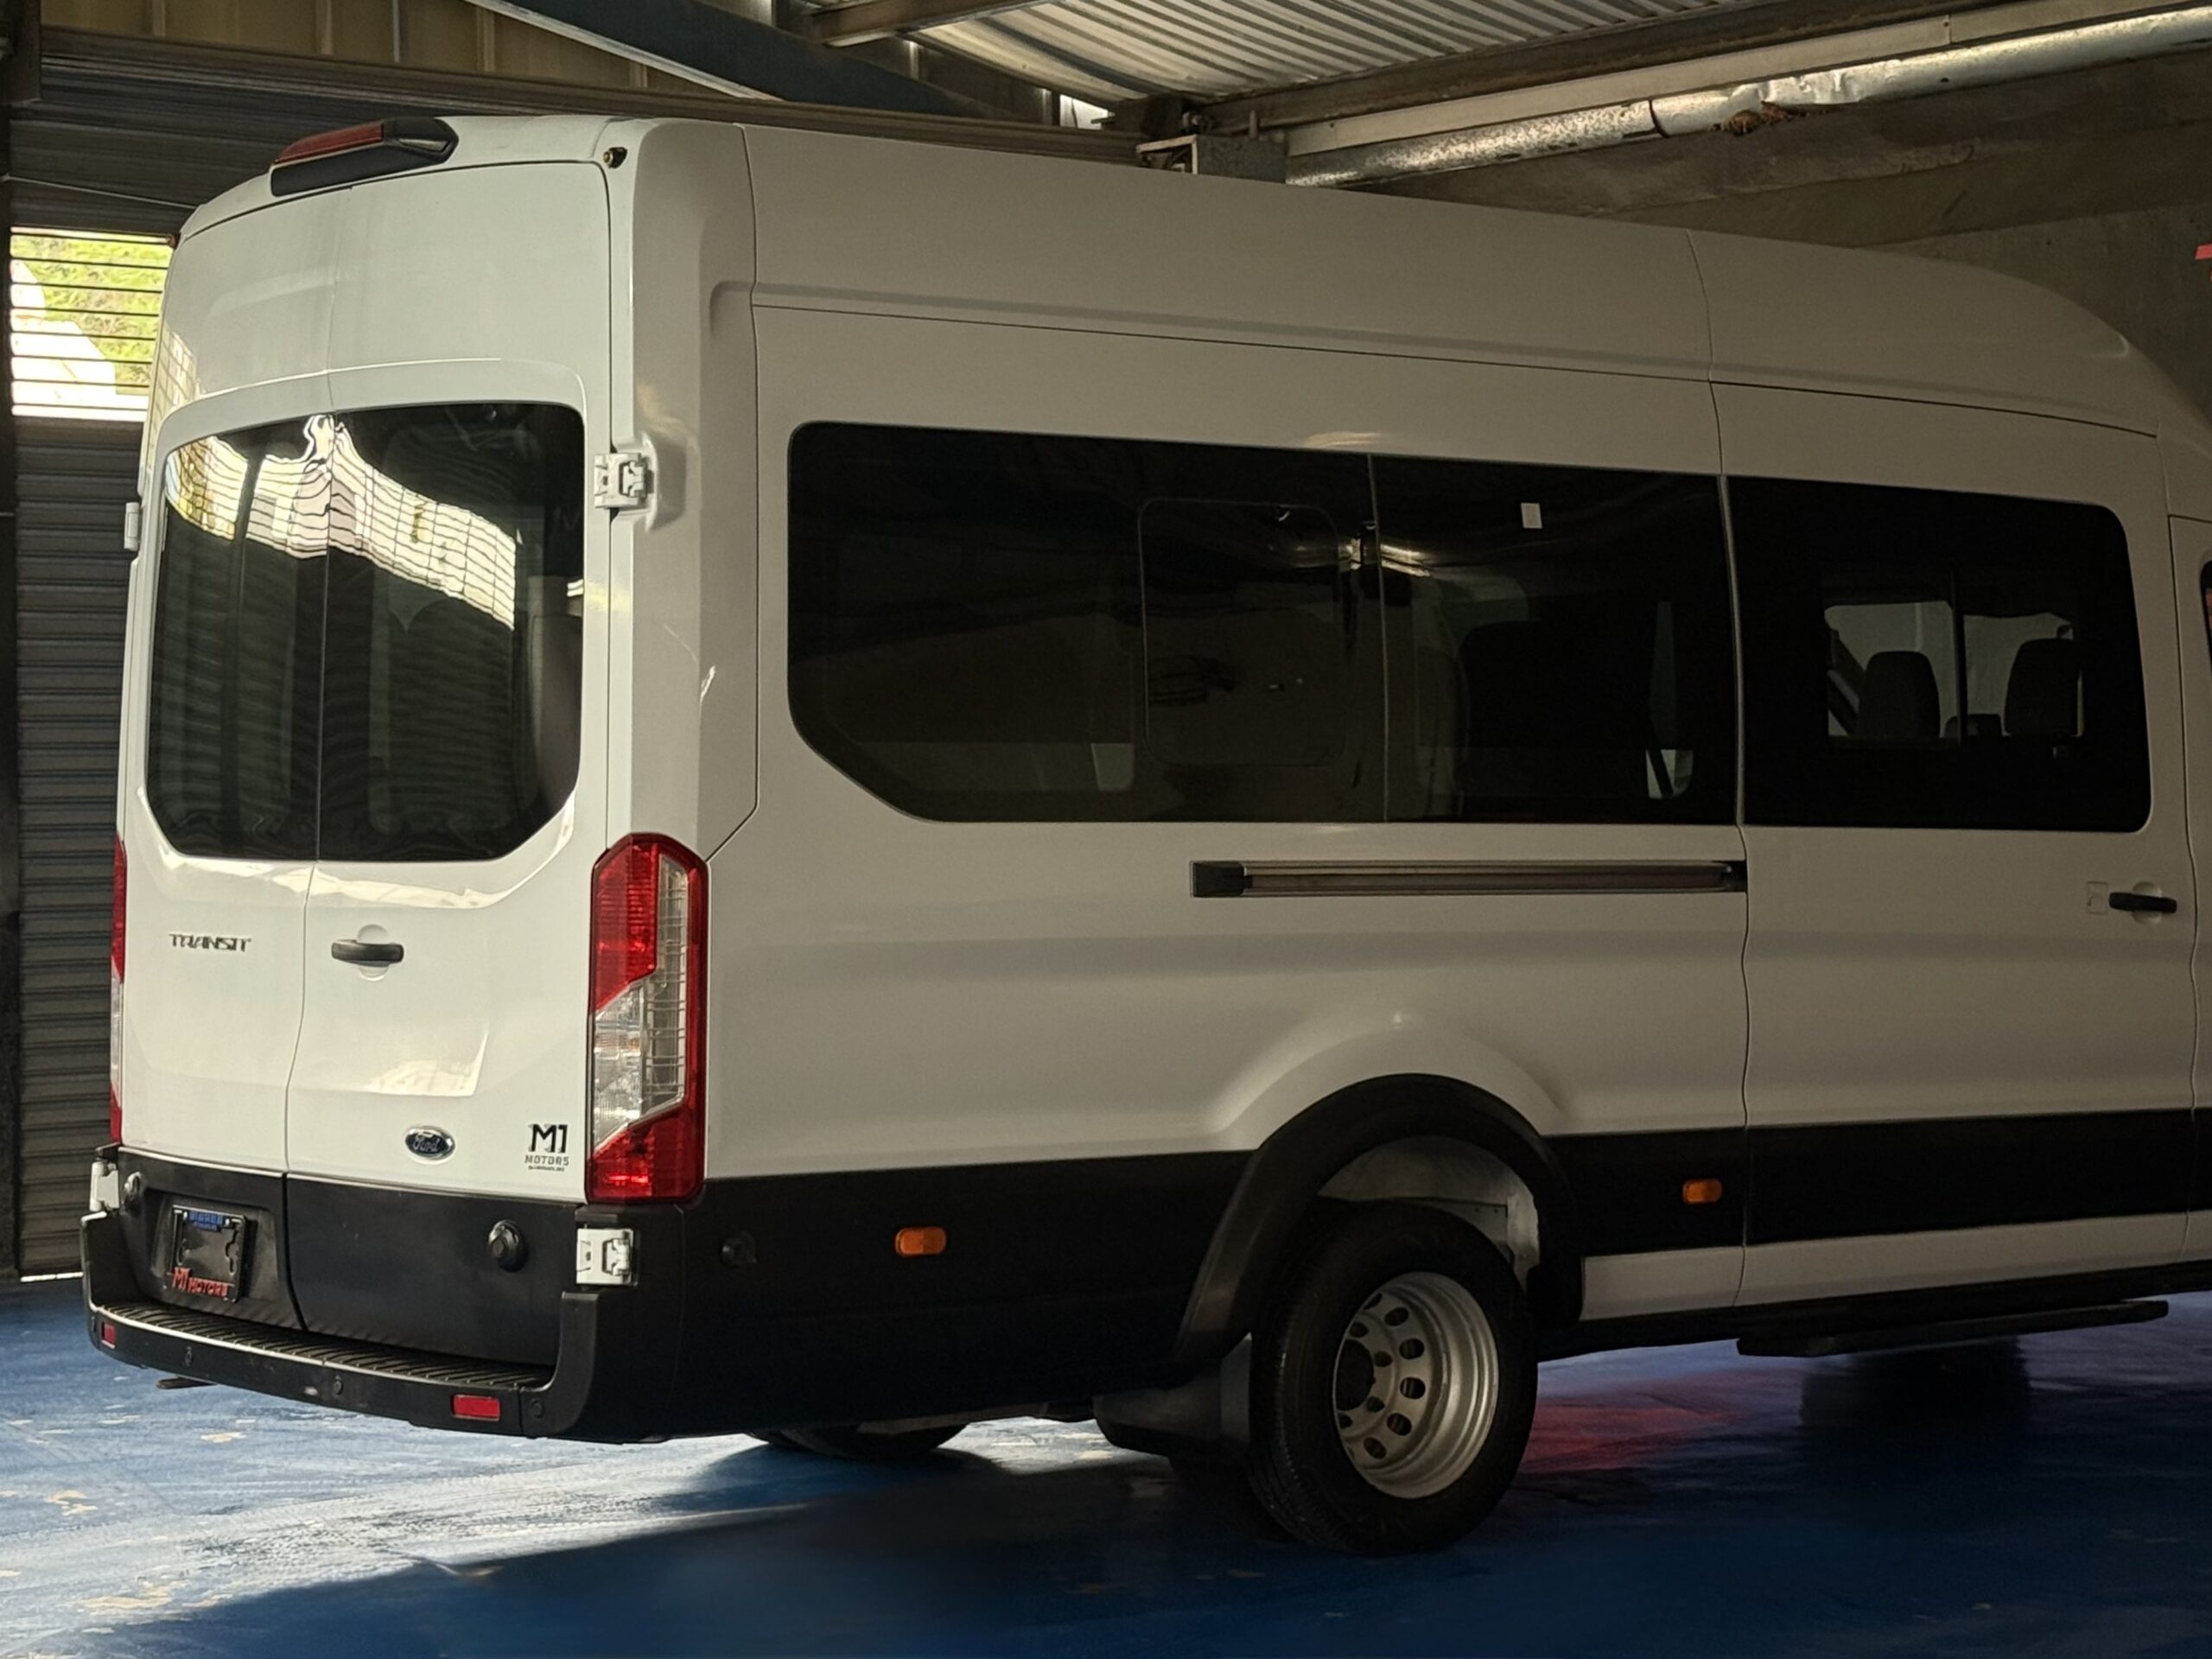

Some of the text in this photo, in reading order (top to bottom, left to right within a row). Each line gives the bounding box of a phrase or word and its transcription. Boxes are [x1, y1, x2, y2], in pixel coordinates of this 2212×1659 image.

[168, 933, 251, 952] TRANSIT
[412, 1132, 441, 1153] Ford
[524, 1154, 569, 1166] MOTORS
